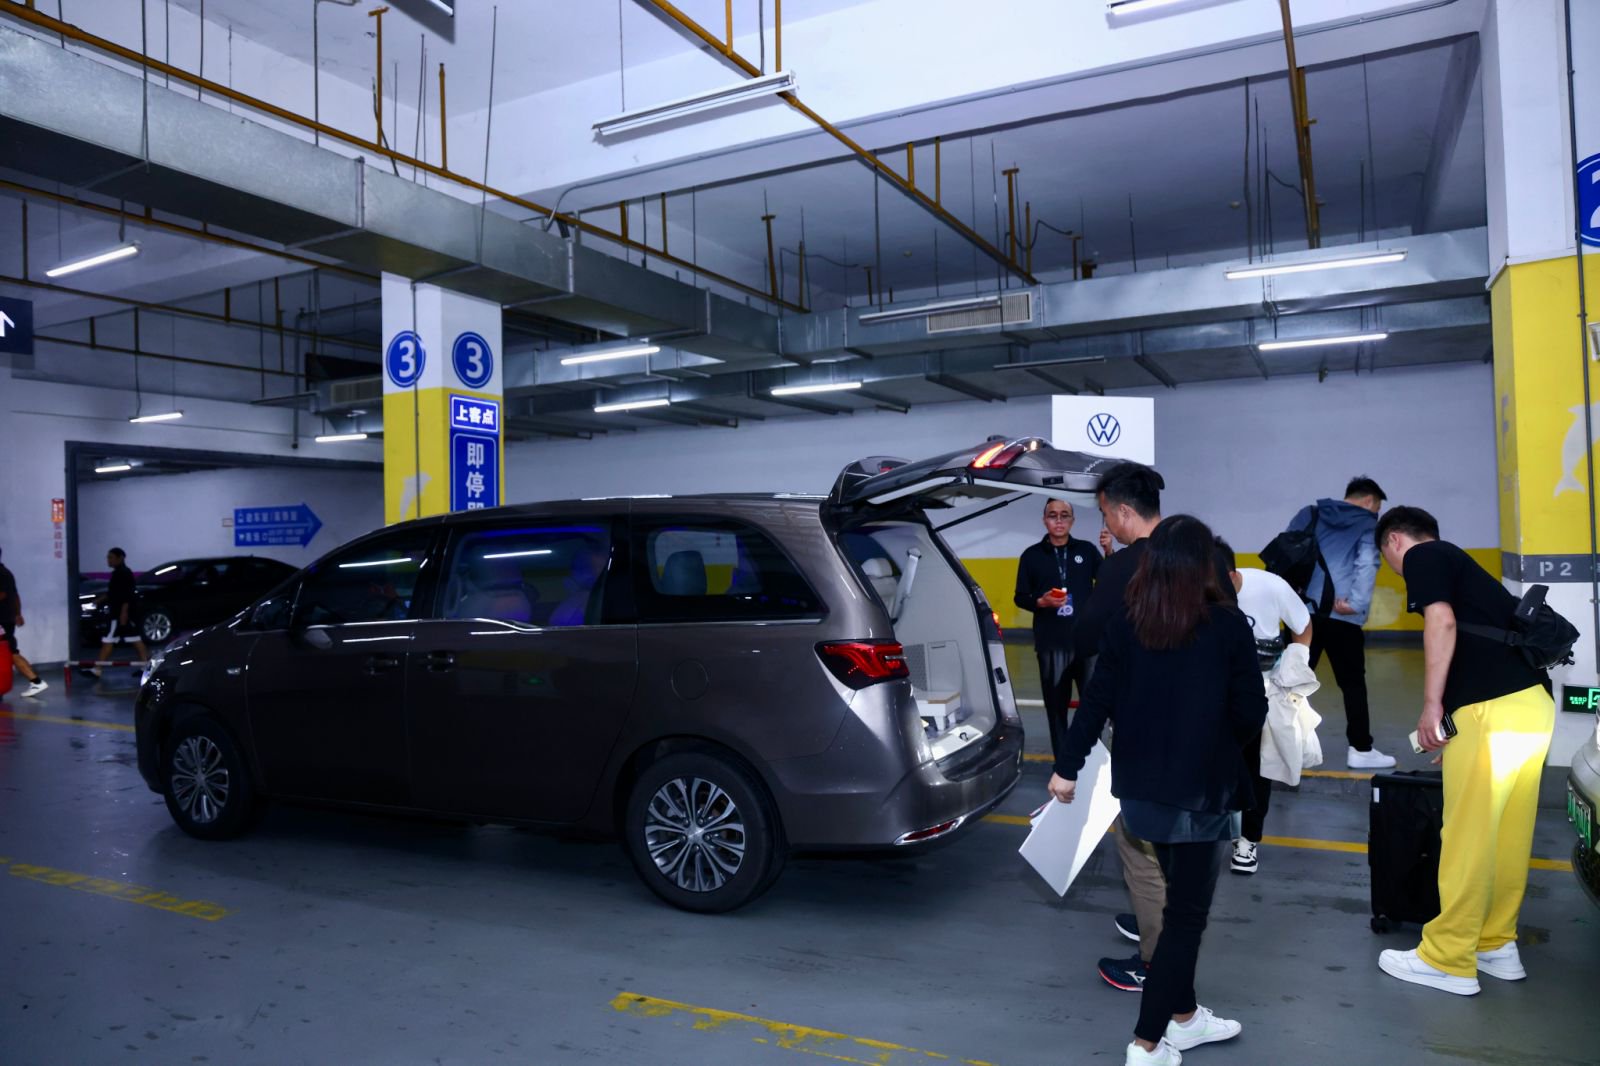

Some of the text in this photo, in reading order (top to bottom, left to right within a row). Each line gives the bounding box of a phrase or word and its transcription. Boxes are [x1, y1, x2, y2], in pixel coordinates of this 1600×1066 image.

[399, 339, 415, 378] 3
[466, 341, 484, 379] 3
[456, 404, 494, 425] 上客点
